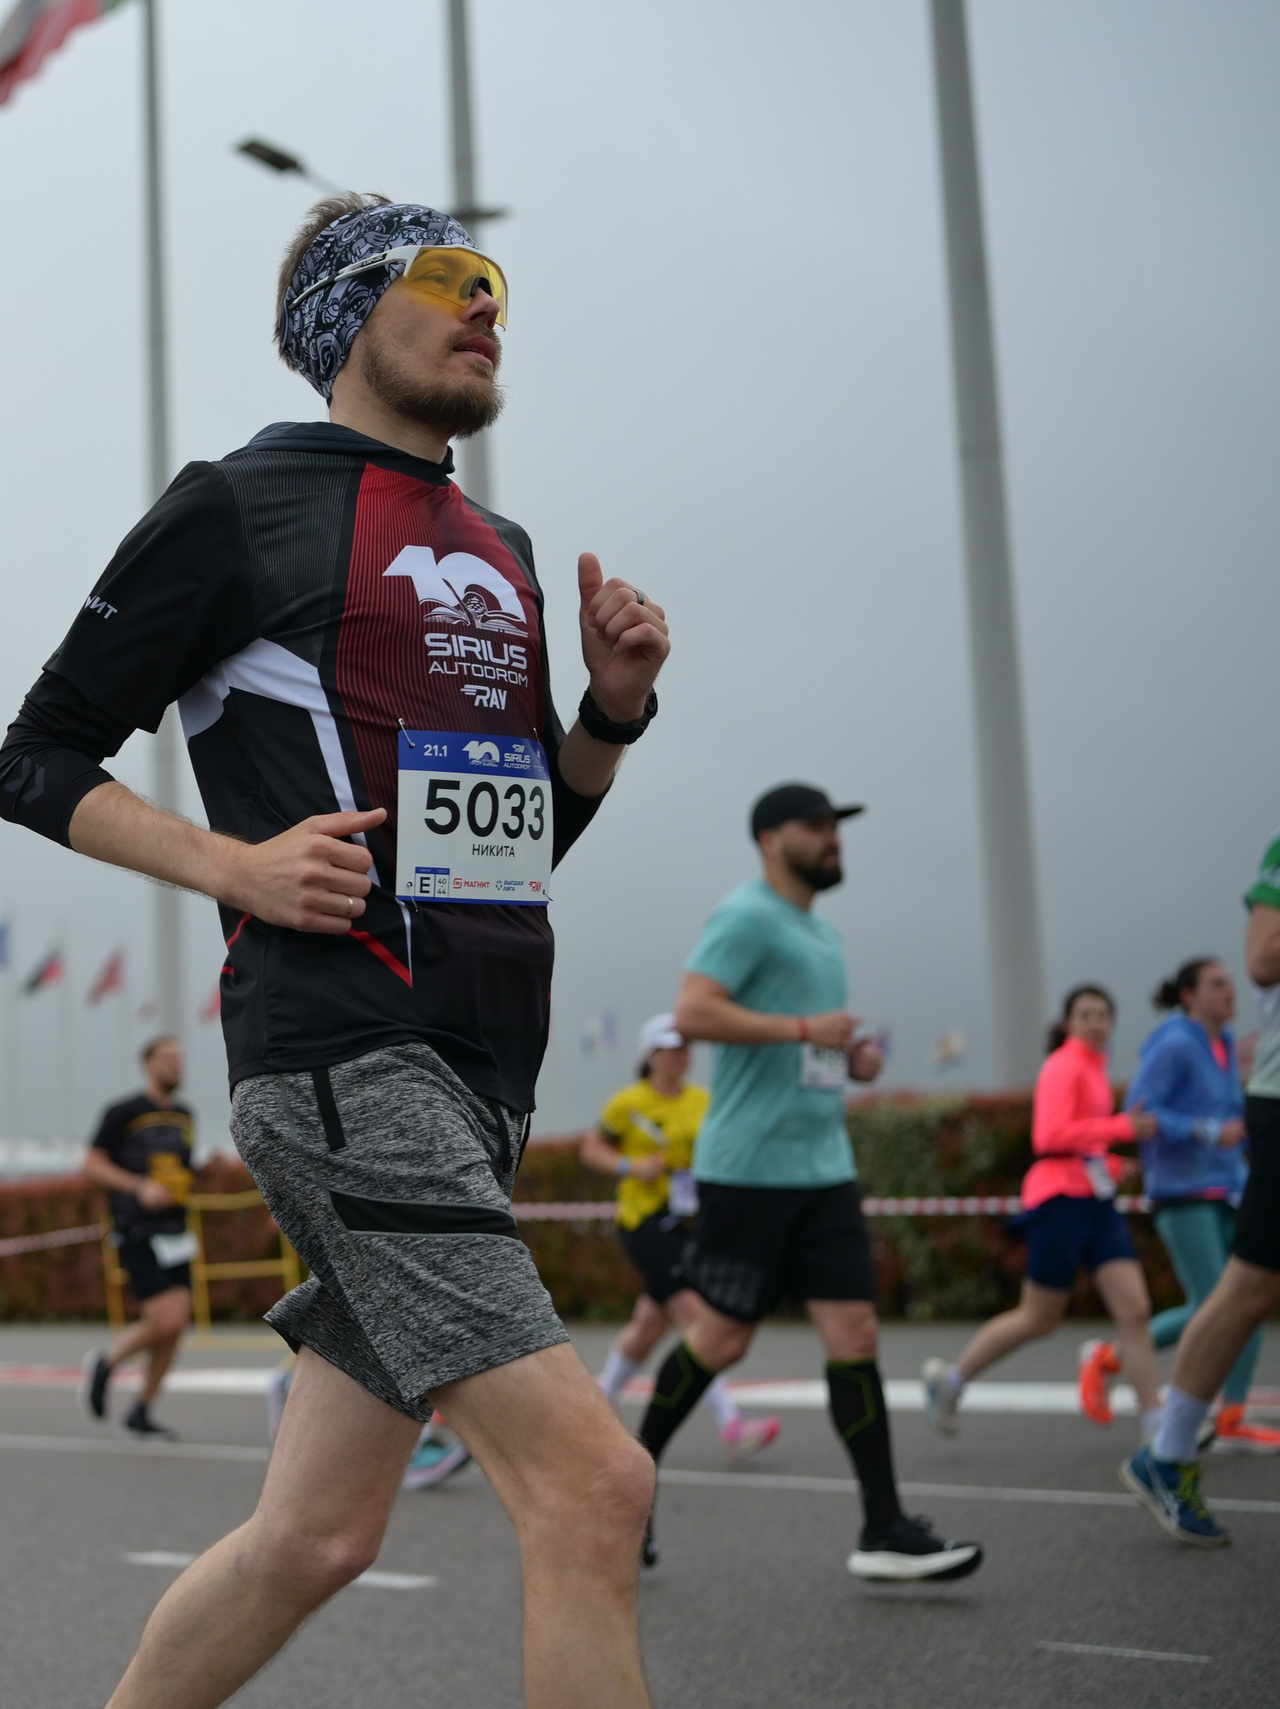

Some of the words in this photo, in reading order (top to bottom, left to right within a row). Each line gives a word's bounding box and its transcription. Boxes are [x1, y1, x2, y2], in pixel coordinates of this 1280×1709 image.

[424, 633, 527, 670] SIRIUS
[428, 661, 528, 687] AUTODROM
[461, 684, 507, 710] RAY
[424, 744, 447, 757] 21.1
[504, 753, 530, 764] SIRIUS
[424, 779, 545, 841] 5033
[472, 844, 515, 857] НИКИТА
[420, 877, 431, 893] E
[463, 881, 490, 889] МАГНИТ
